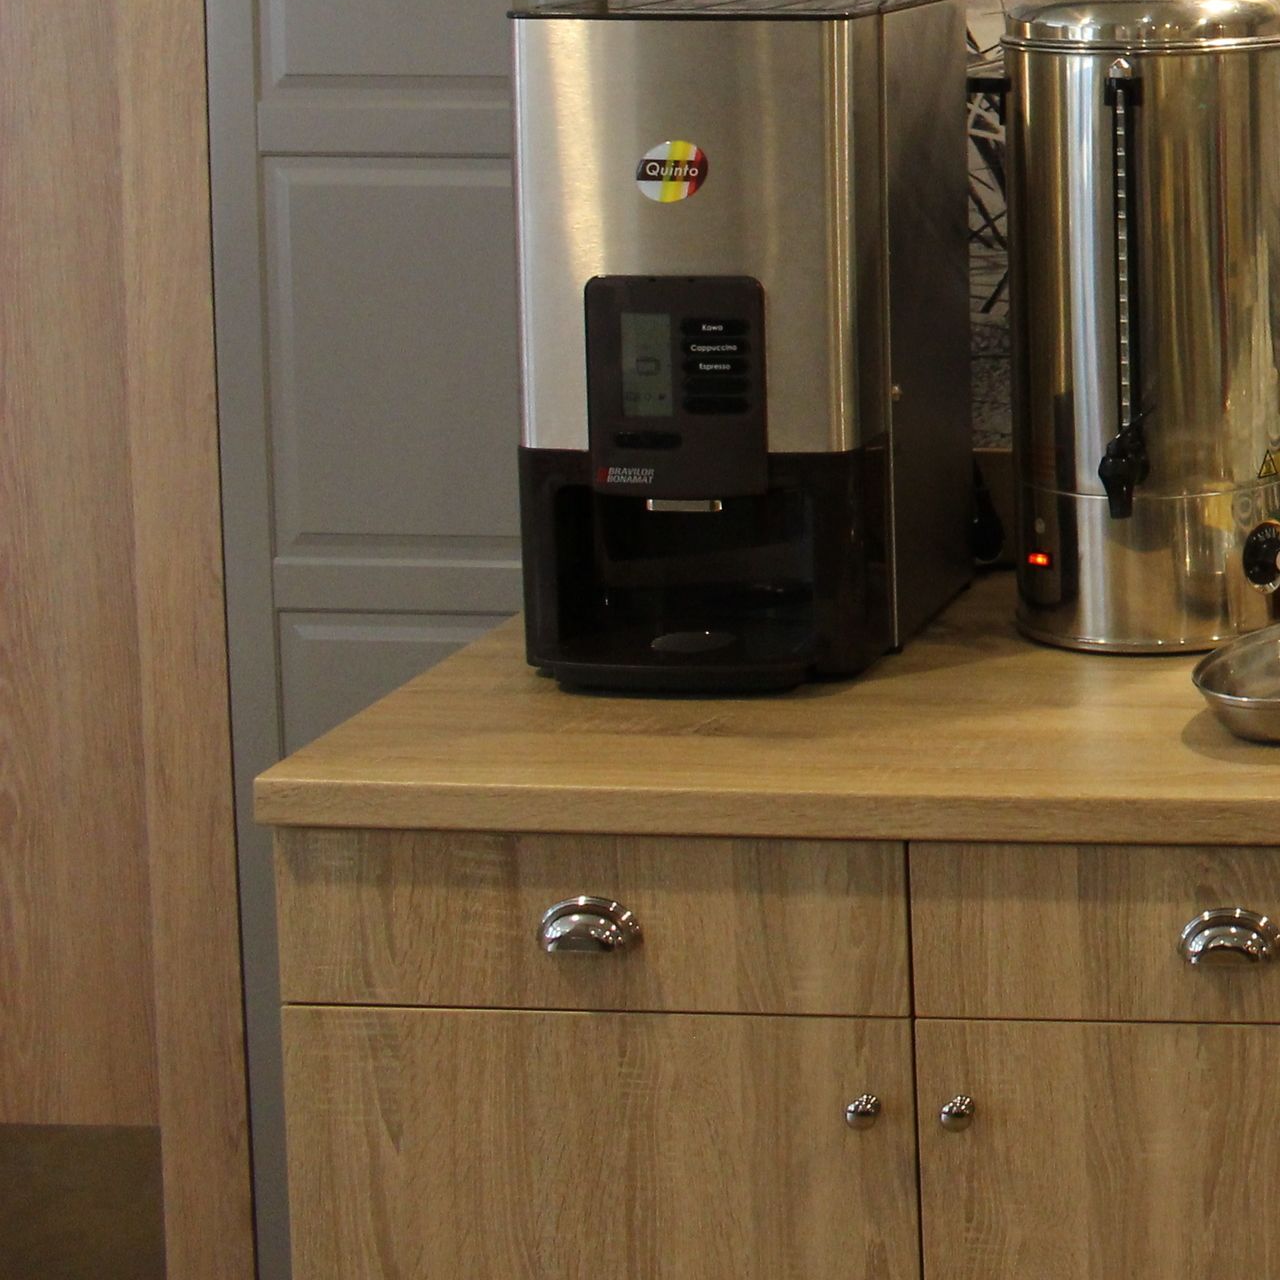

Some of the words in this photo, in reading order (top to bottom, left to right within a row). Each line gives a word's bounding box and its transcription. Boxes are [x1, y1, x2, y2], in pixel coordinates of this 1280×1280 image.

[646, 162, 699, 177] Quinto
[702, 323, 723, 332] Kawa
[690, 344, 738, 353] Cappuccino
[699, 363, 731, 371] Espresso
[608, 467, 654, 476] BRAVILOR
[607, 475, 653, 484] BONAMAT
